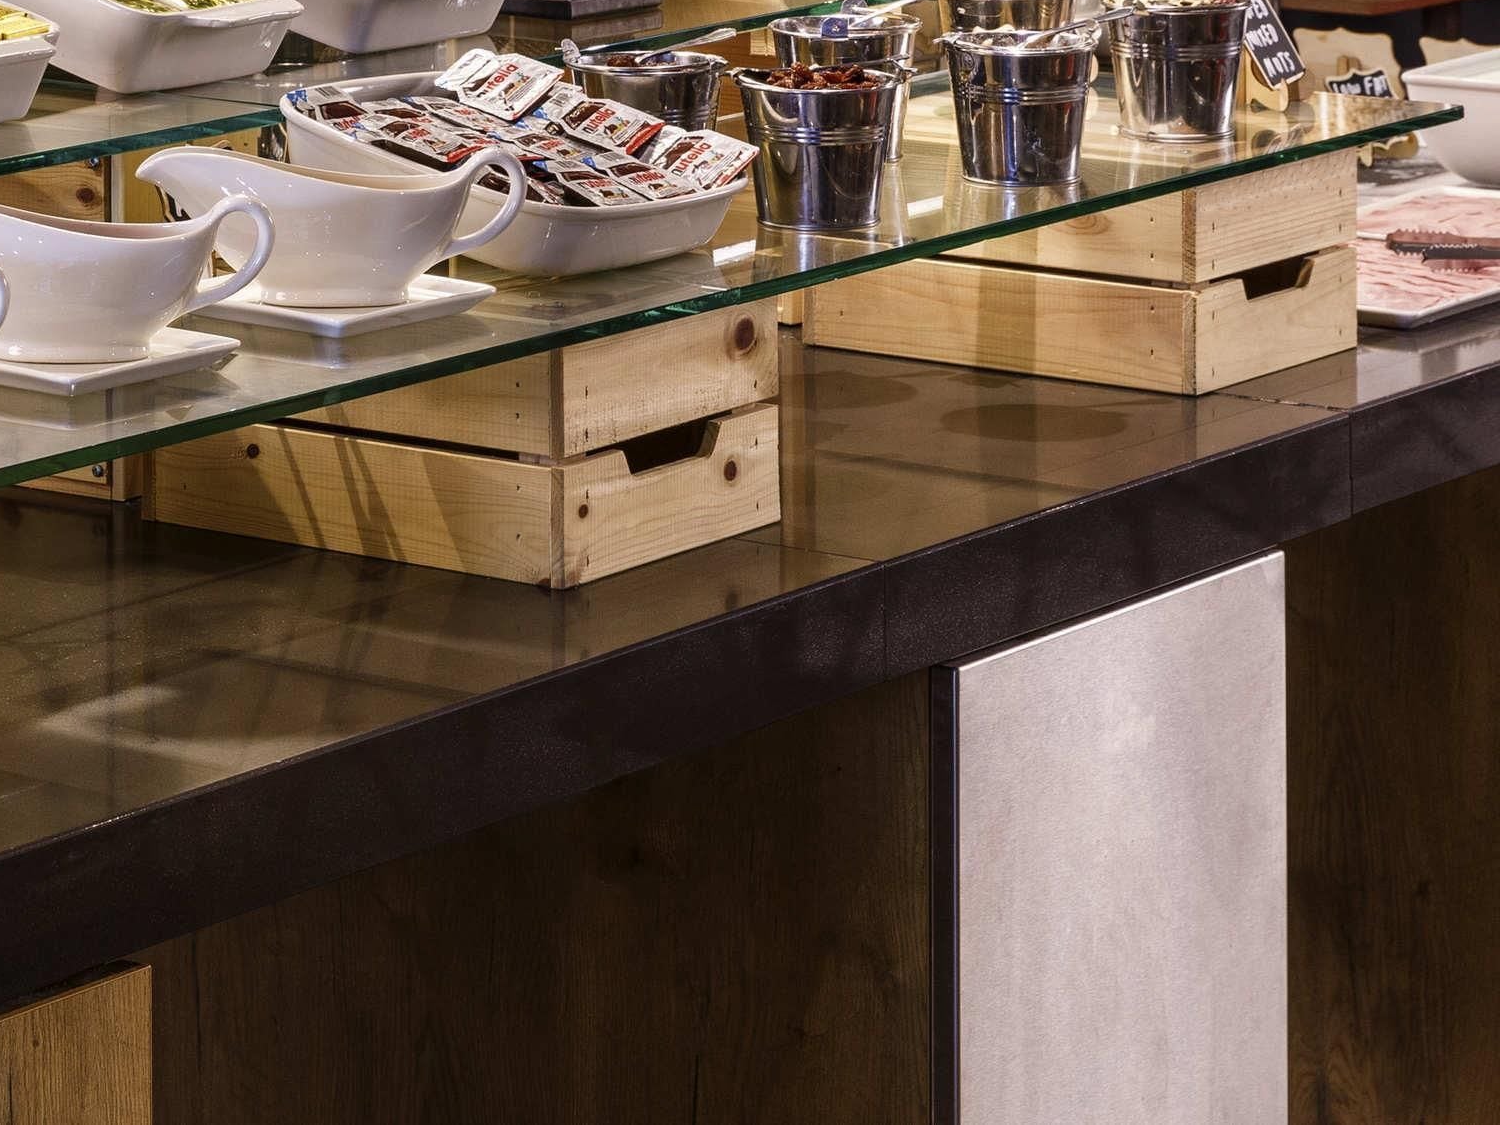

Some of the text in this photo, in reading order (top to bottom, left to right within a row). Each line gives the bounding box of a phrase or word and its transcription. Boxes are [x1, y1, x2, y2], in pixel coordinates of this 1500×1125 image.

[477, 61, 521, 98] nutella
[1263, 51, 1296, 78] NUTS
[582, 107, 617, 135] nutella
[671, 141, 713, 177] nutella
